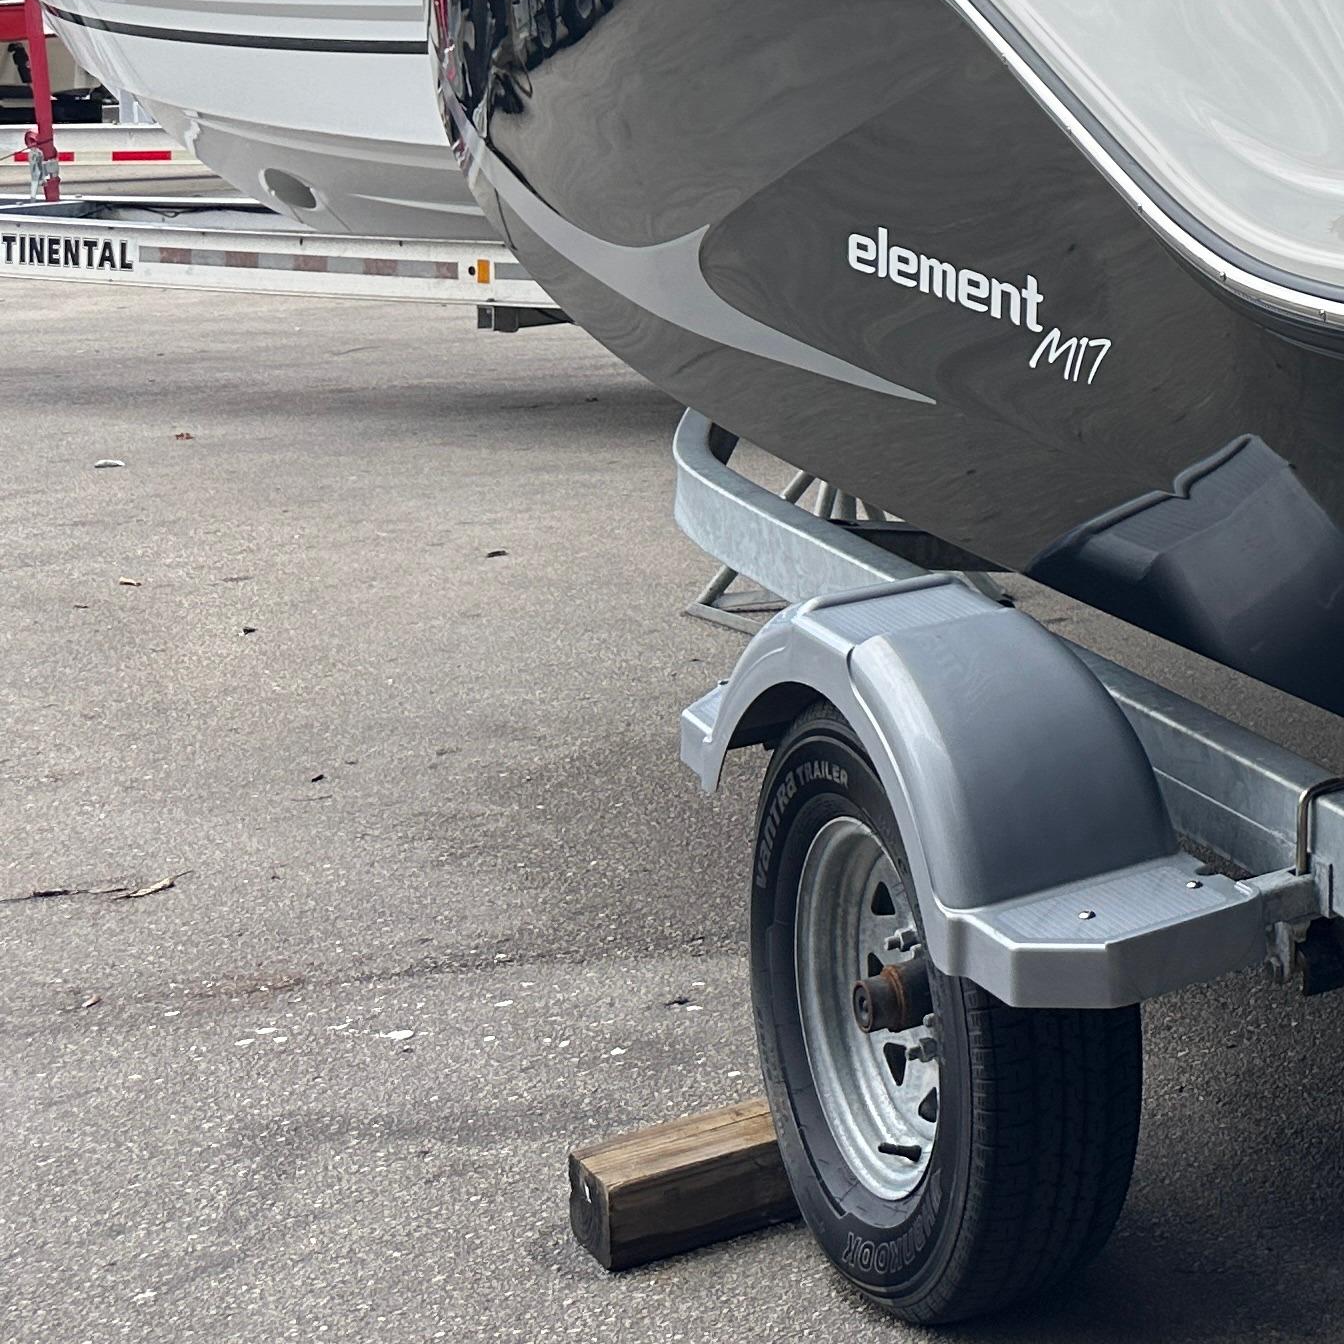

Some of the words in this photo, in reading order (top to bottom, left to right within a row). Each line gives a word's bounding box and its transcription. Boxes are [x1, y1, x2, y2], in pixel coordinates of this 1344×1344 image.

[1, 233, 134, 271] TINENTAL
[848, 226, 1044, 332] element
[1028, 327, 1111, 384] M17
